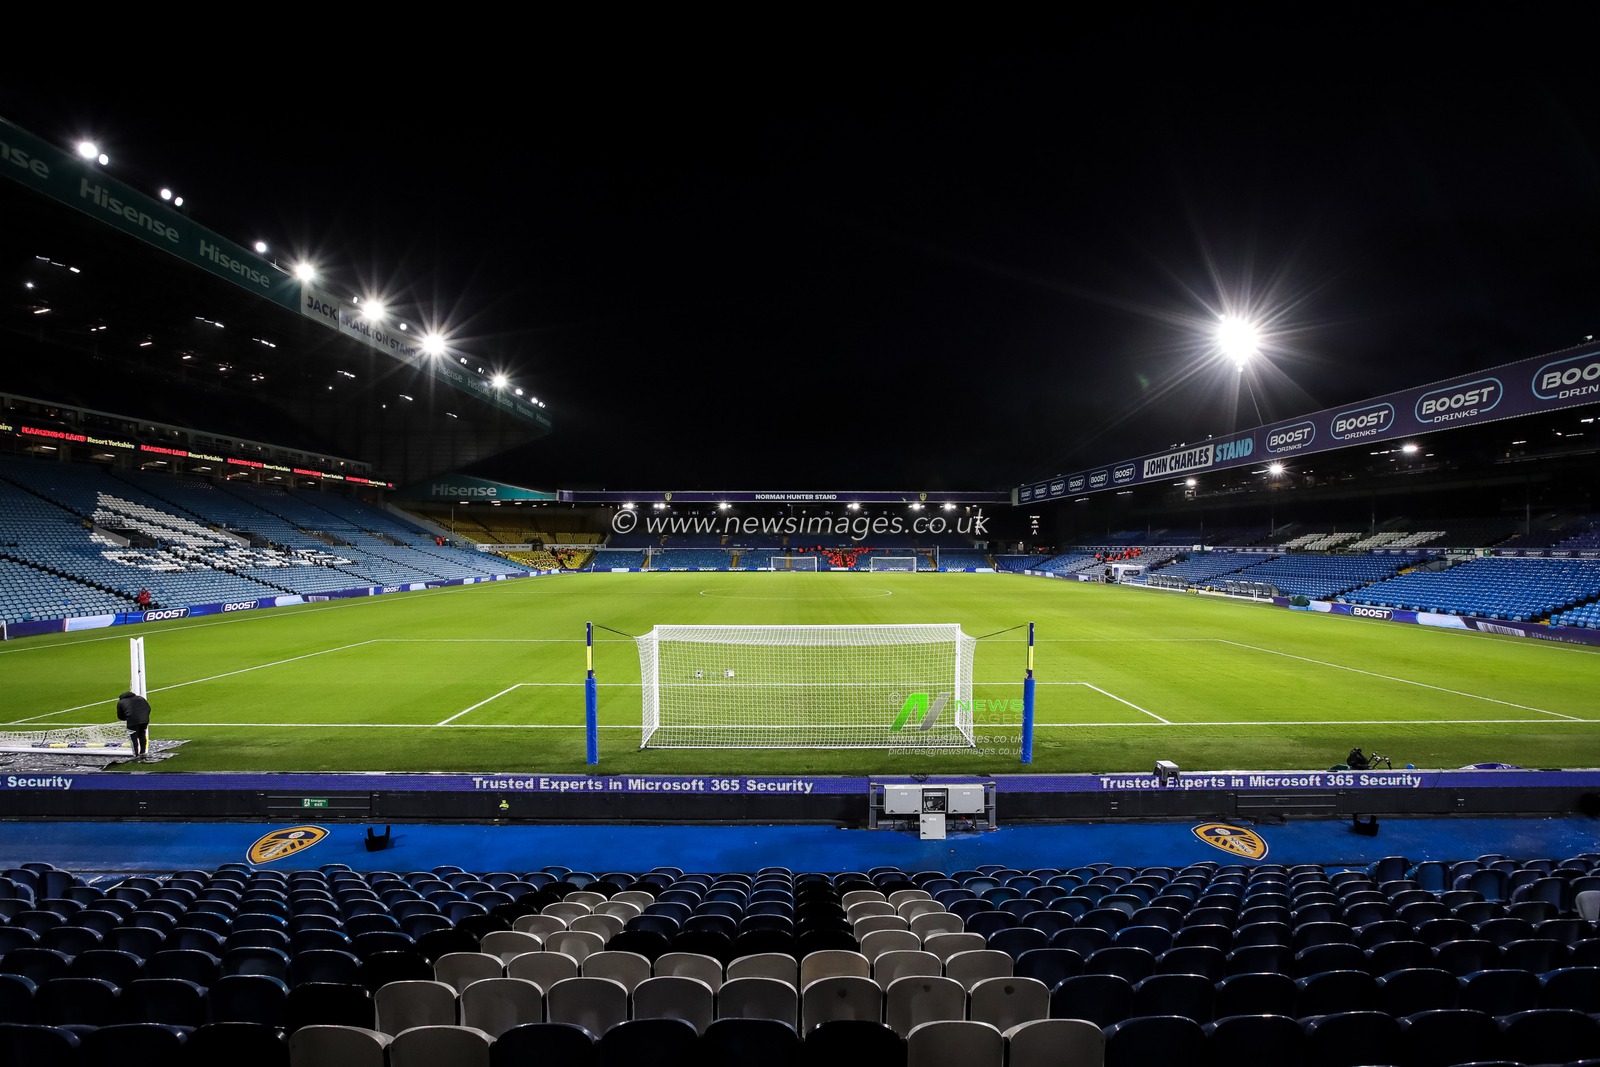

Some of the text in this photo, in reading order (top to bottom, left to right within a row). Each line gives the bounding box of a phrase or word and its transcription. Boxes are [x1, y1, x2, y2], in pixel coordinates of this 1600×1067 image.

[79, 178, 180, 243] Hisense
[199, 240, 270, 288] Hisense
[306, 295, 338, 321] JACK
[1421, 386, 1495, 415] BOOST
[1335, 410, 1389, 433] BOOST
[1433, 408, 1478, 423] DRINKS
[1269, 427, 1312, 446] BOOST
[1344, 428, 1377, 440] DRINKS
[87, 436, 108, 445] Resort
[108, 439, 135, 449] Yorkshire
[1276, 444, 1302, 453] DRINKS
[1145, 437, 1254, 476] JOHN CHARLES STAND
[1090, 473, 1107, 484] BOOST
[1114, 467, 1134, 479] BOOST
[431, 484, 497, 497] Hisense
[224, 600, 257, 612] BOOST
[1353, 607, 1390, 619] BOOST
[146, 608, 188, 621] BOOST
[7, 775, 73, 790] Security
[472, 777, 814, 794] Trusted Experts in Microsoft 365 Security
[1100, 774, 1422, 790] Trusted Experts in Microsoft 365 Security
